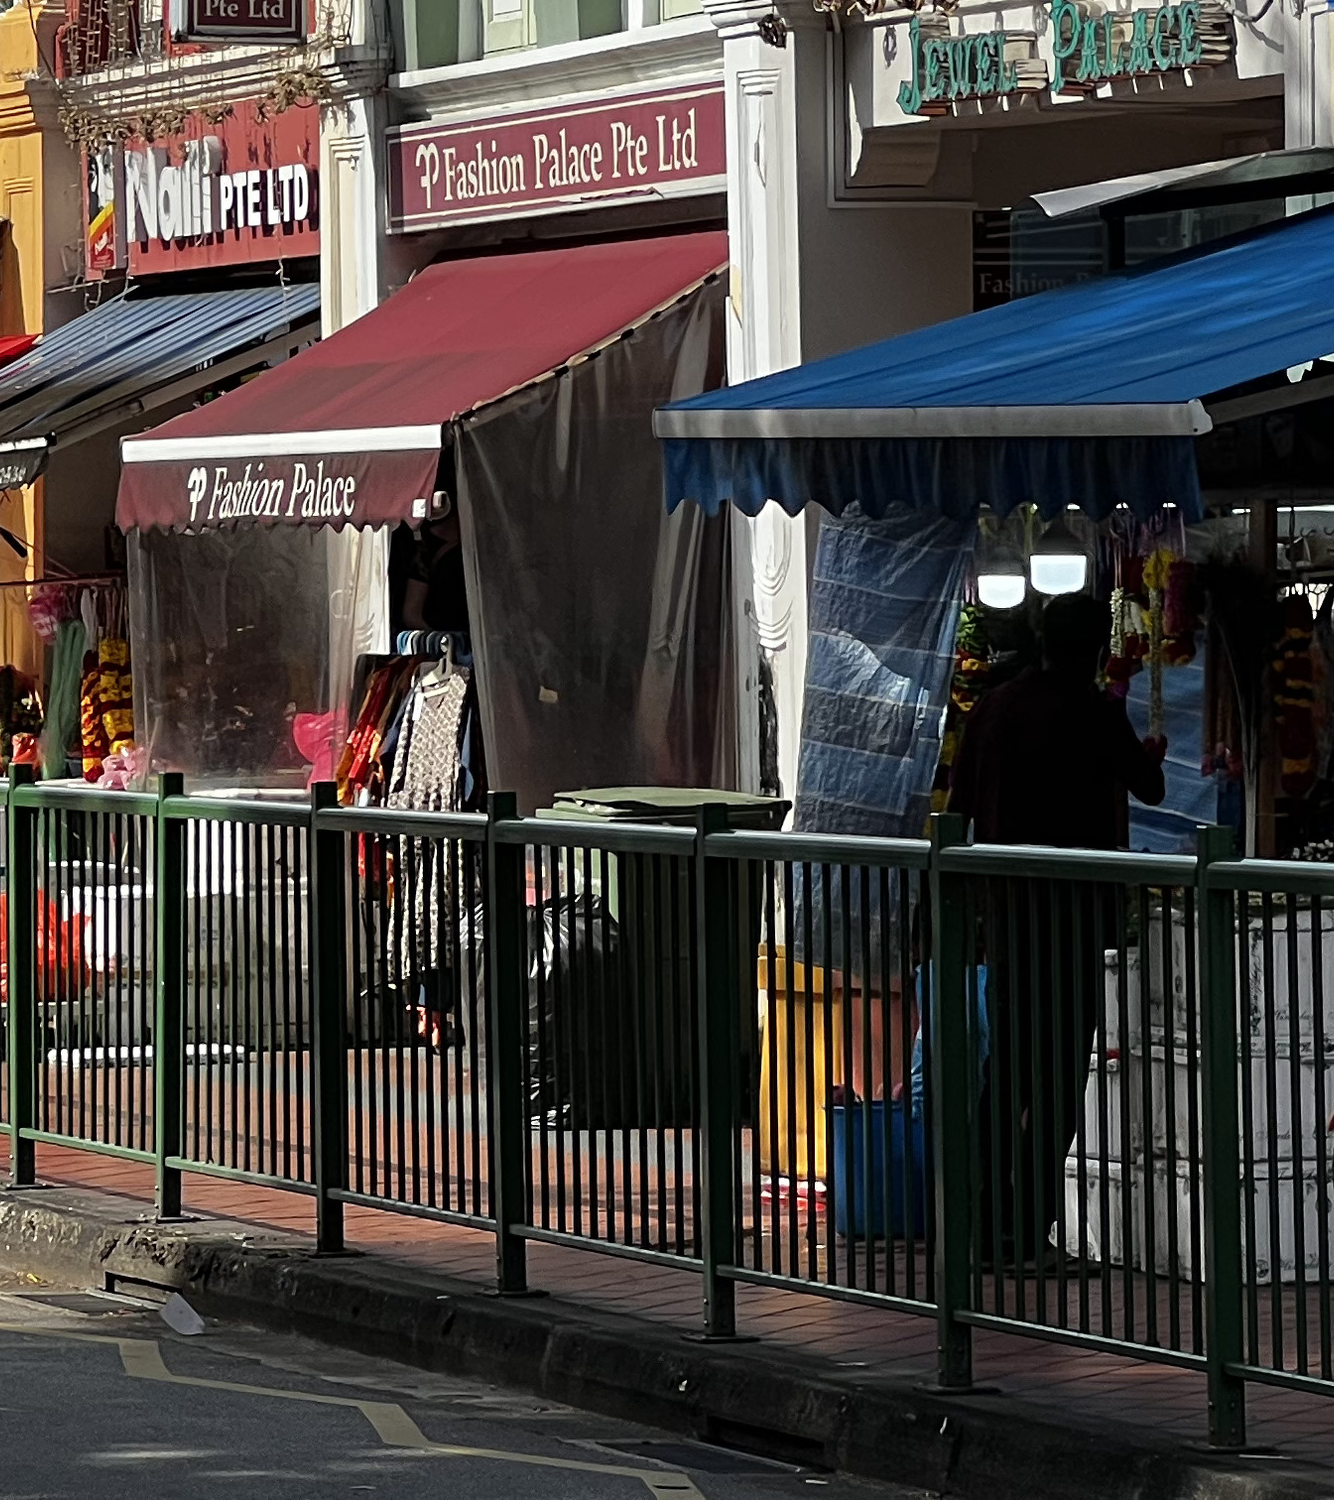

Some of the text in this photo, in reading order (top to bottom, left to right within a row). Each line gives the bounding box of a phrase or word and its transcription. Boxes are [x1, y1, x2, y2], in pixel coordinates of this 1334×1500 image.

[897, 15, 1018, 114] JEWEL
[125, 136, 220, 243] Nalli
[220, 170, 262, 231] PTE
[267, 164, 309, 226] LTD
[443, 107, 698, 200] Fashion Palace Pte Ltd
[208, 461, 355, 520] Fashion Palace
